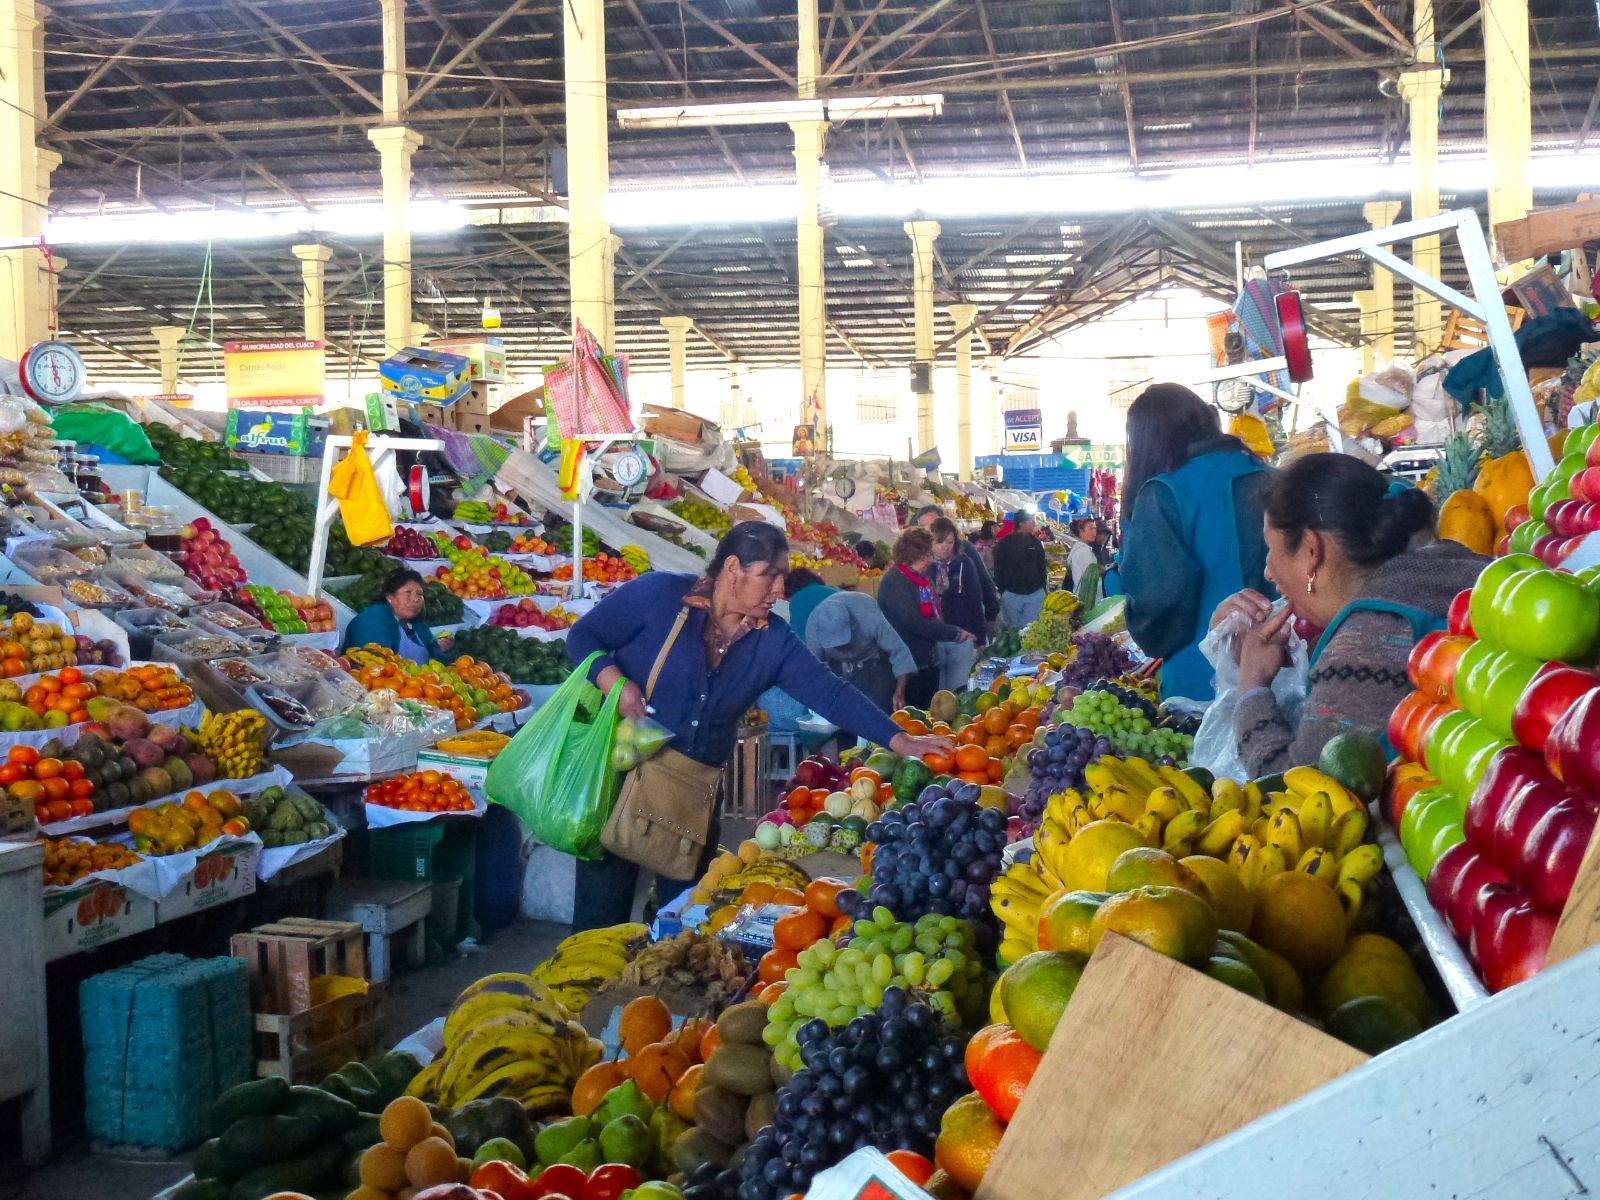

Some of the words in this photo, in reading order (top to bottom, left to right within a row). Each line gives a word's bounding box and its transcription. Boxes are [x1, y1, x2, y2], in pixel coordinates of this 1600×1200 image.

[241, 343, 284, 351] MUNICIPALIDAD
[239, 363, 264, 372] Carnes
[259, 399, 295, 407] MUNICIPAL
[240, 432, 287, 448] alfrut
[1012, 431, 1037, 442] VISA
[1078, 451, 1118, 462] SALIDA
